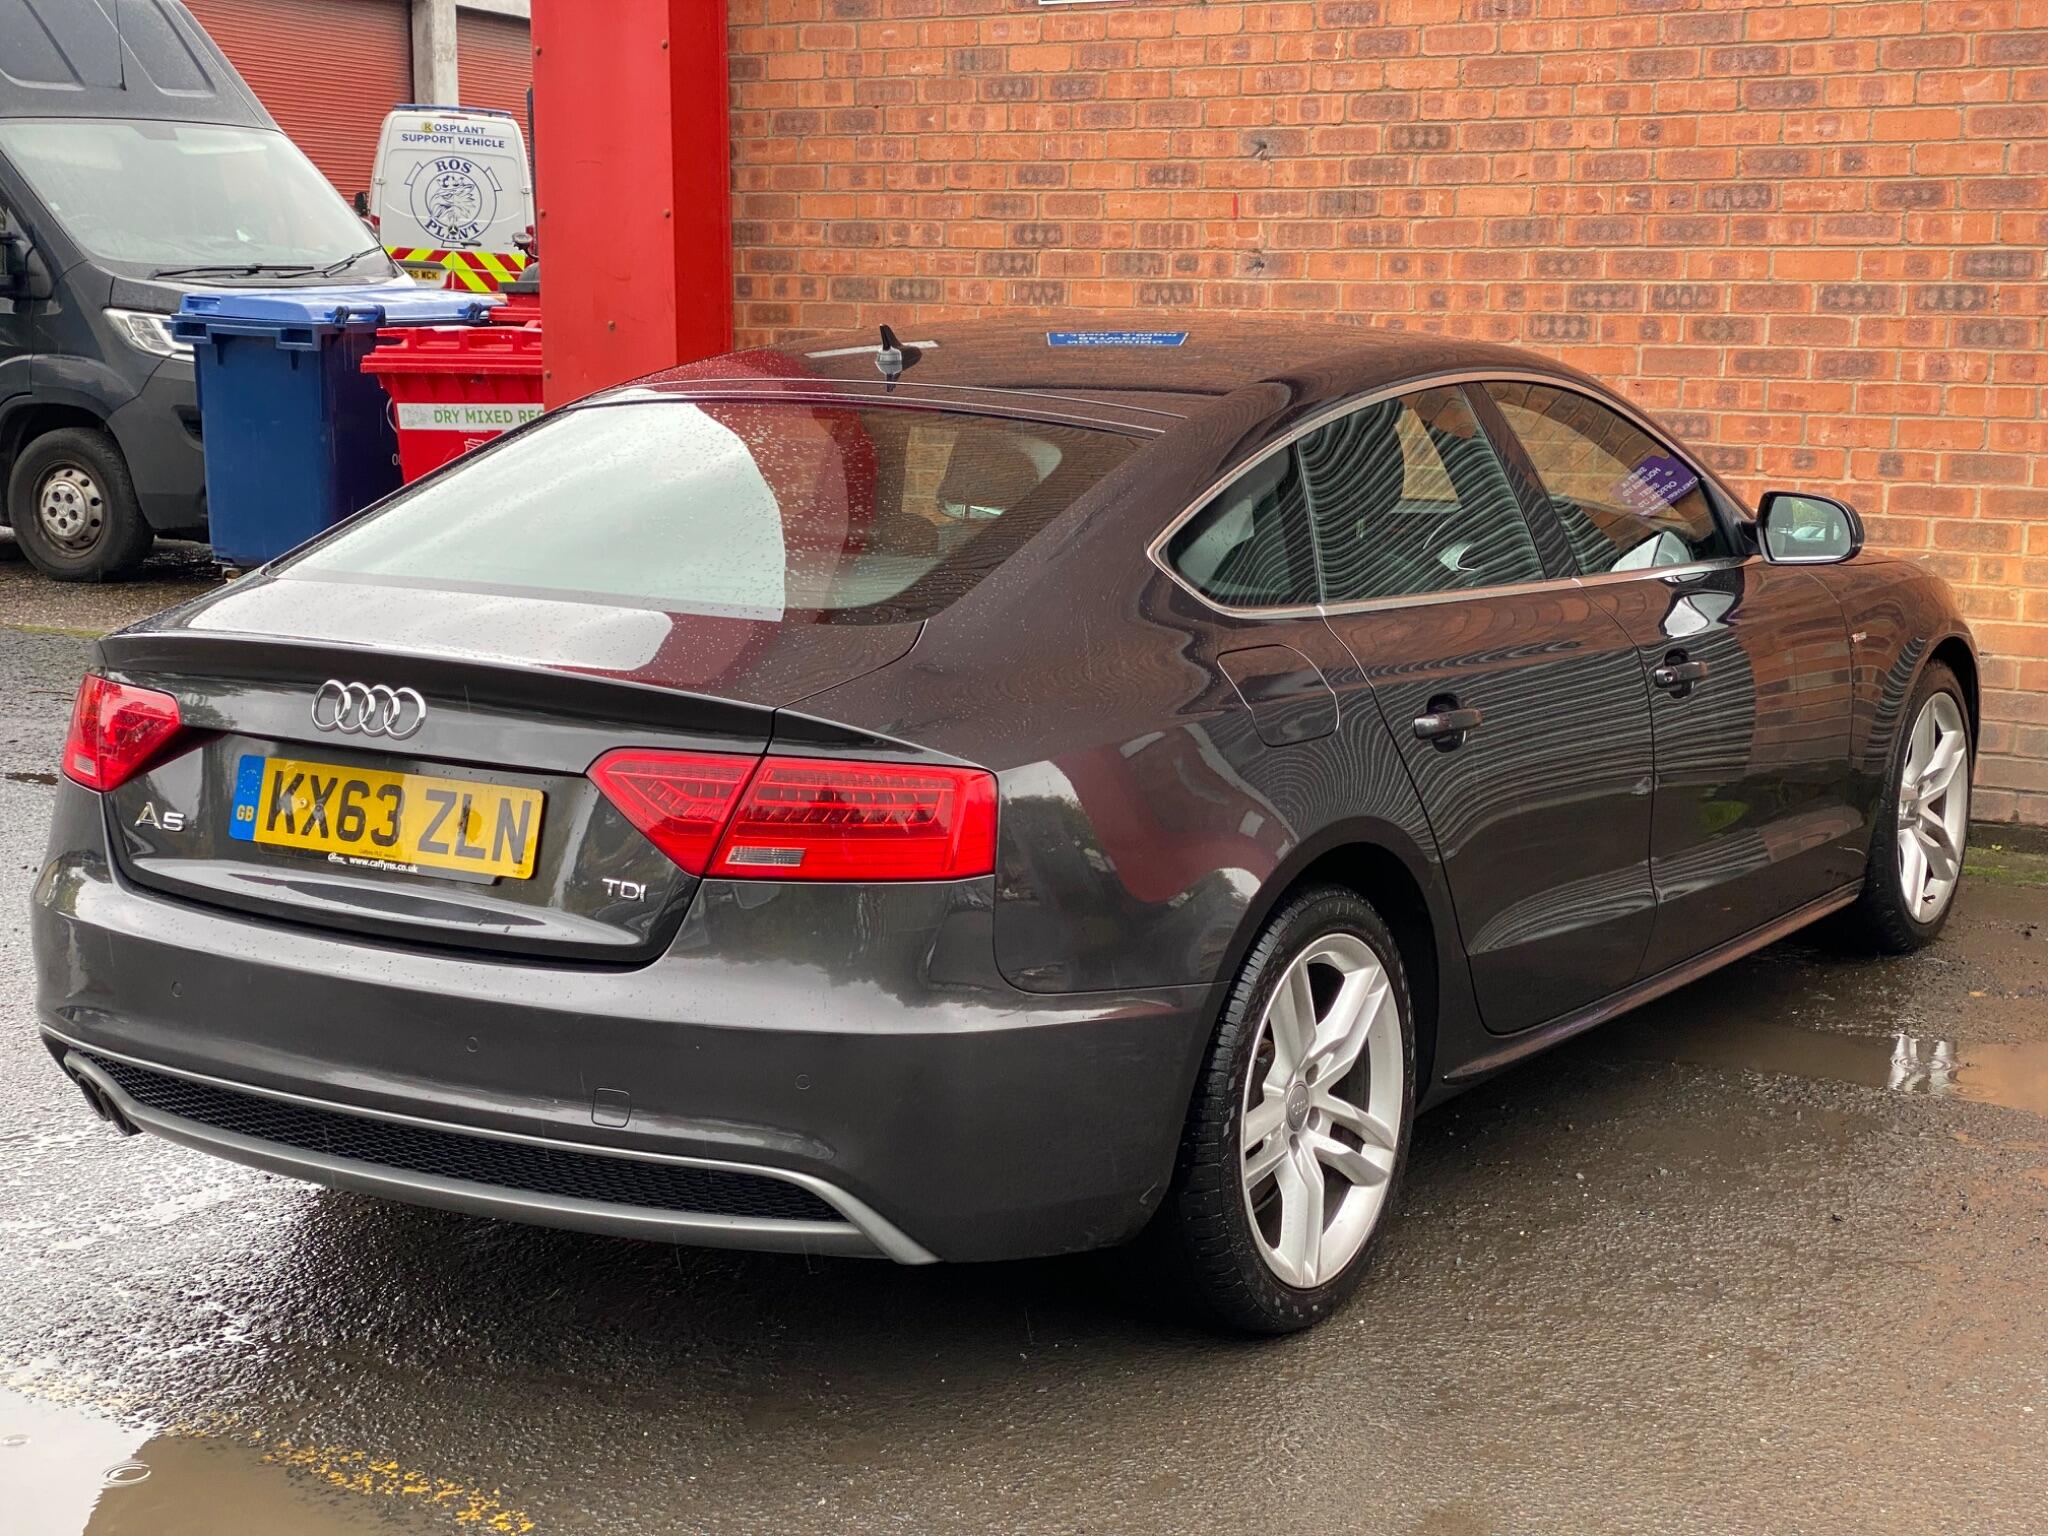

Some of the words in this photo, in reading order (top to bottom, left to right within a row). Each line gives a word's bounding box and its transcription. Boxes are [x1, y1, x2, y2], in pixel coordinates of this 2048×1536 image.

[401, 133, 454, 144] SUPPORT
[458, 137, 505, 148] VEHICLE
[435, 159, 472, 173] ROS
[434, 410, 459, 423] DRY
[465, 410, 513, 424] MIXED
[134, 801, 185, 831] A5
[236, 804, 254, 822] GB
[266, 770, 405, 846] KX63
[417, 788, 532, 865] ZLN
[349, 857, 418, 873] www.caffyns.co.uk
[602, 878, 646, 903] TDI
